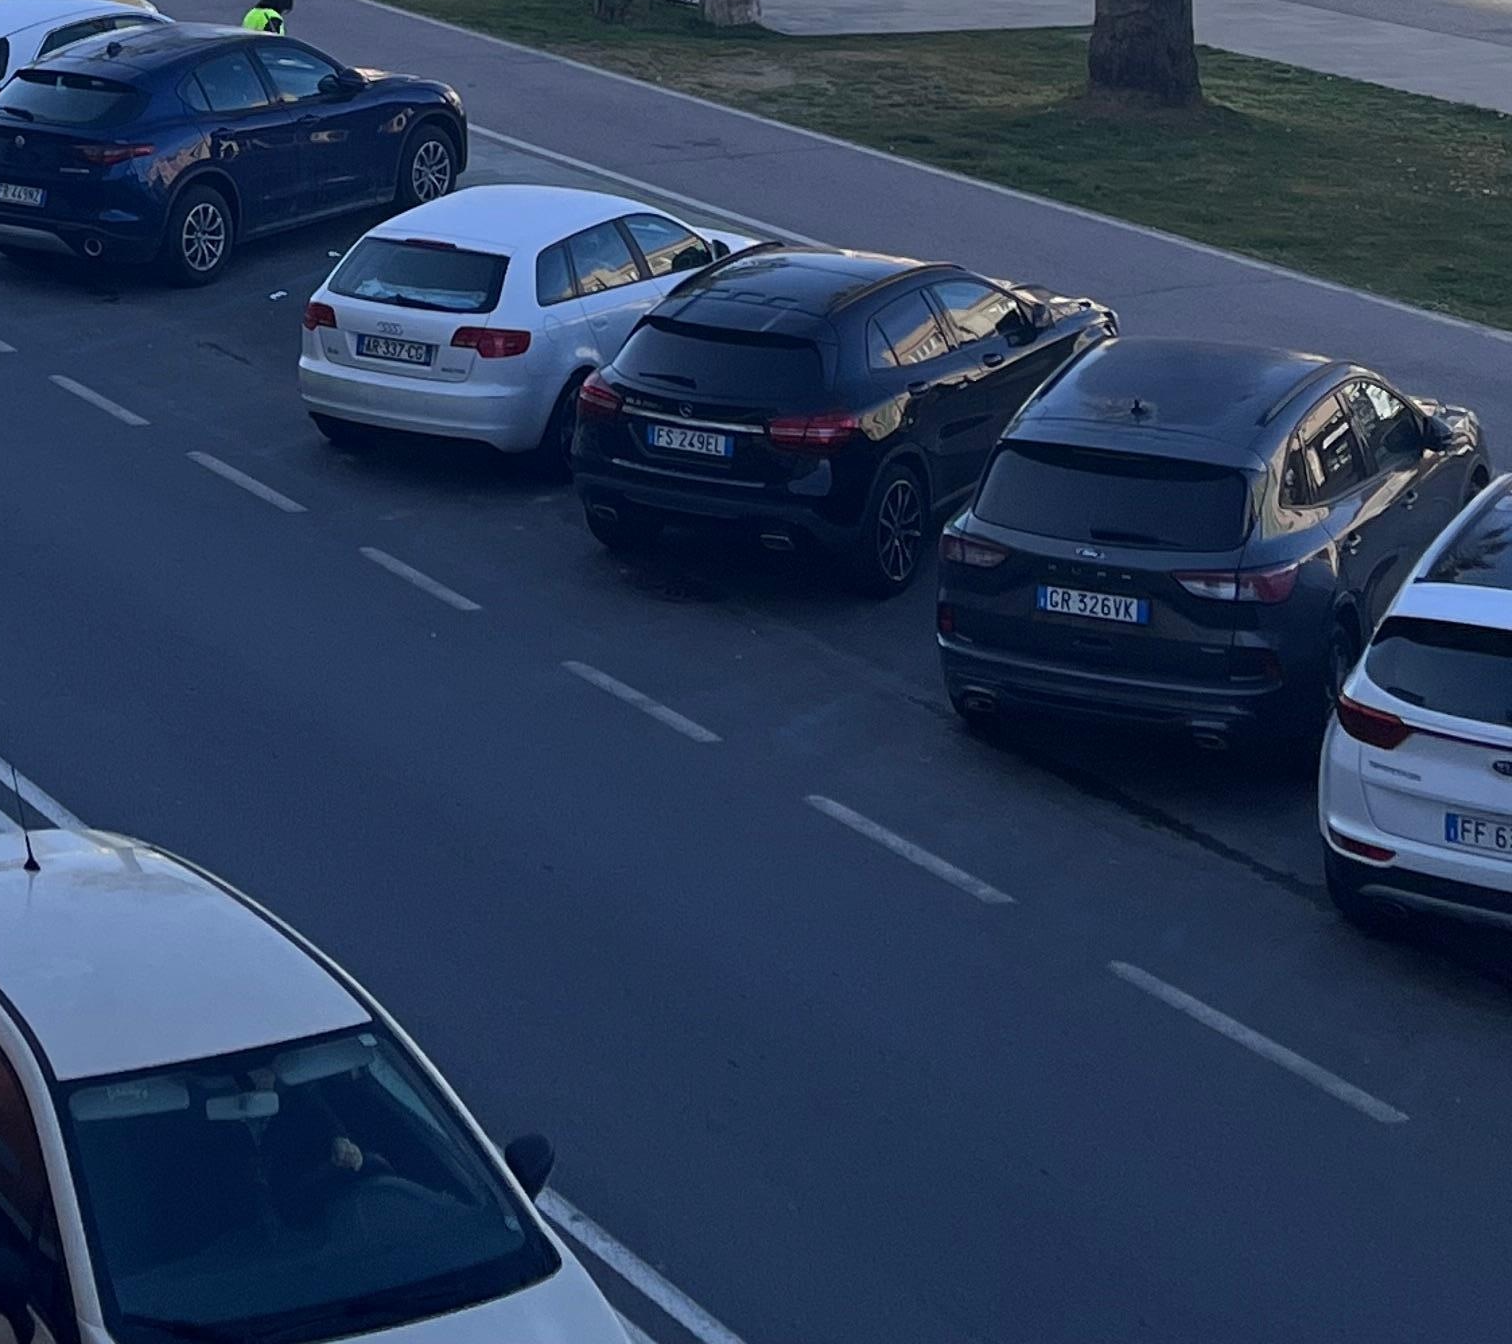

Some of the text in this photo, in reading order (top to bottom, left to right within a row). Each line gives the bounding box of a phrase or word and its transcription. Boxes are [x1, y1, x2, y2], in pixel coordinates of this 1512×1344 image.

[656, 428, 723, 454] FS 249EL
[1049, 589, 1072, 611] GR
[1078, 593, 1134, 620] 326VK
[1461, 818, 1487, 843] FF
